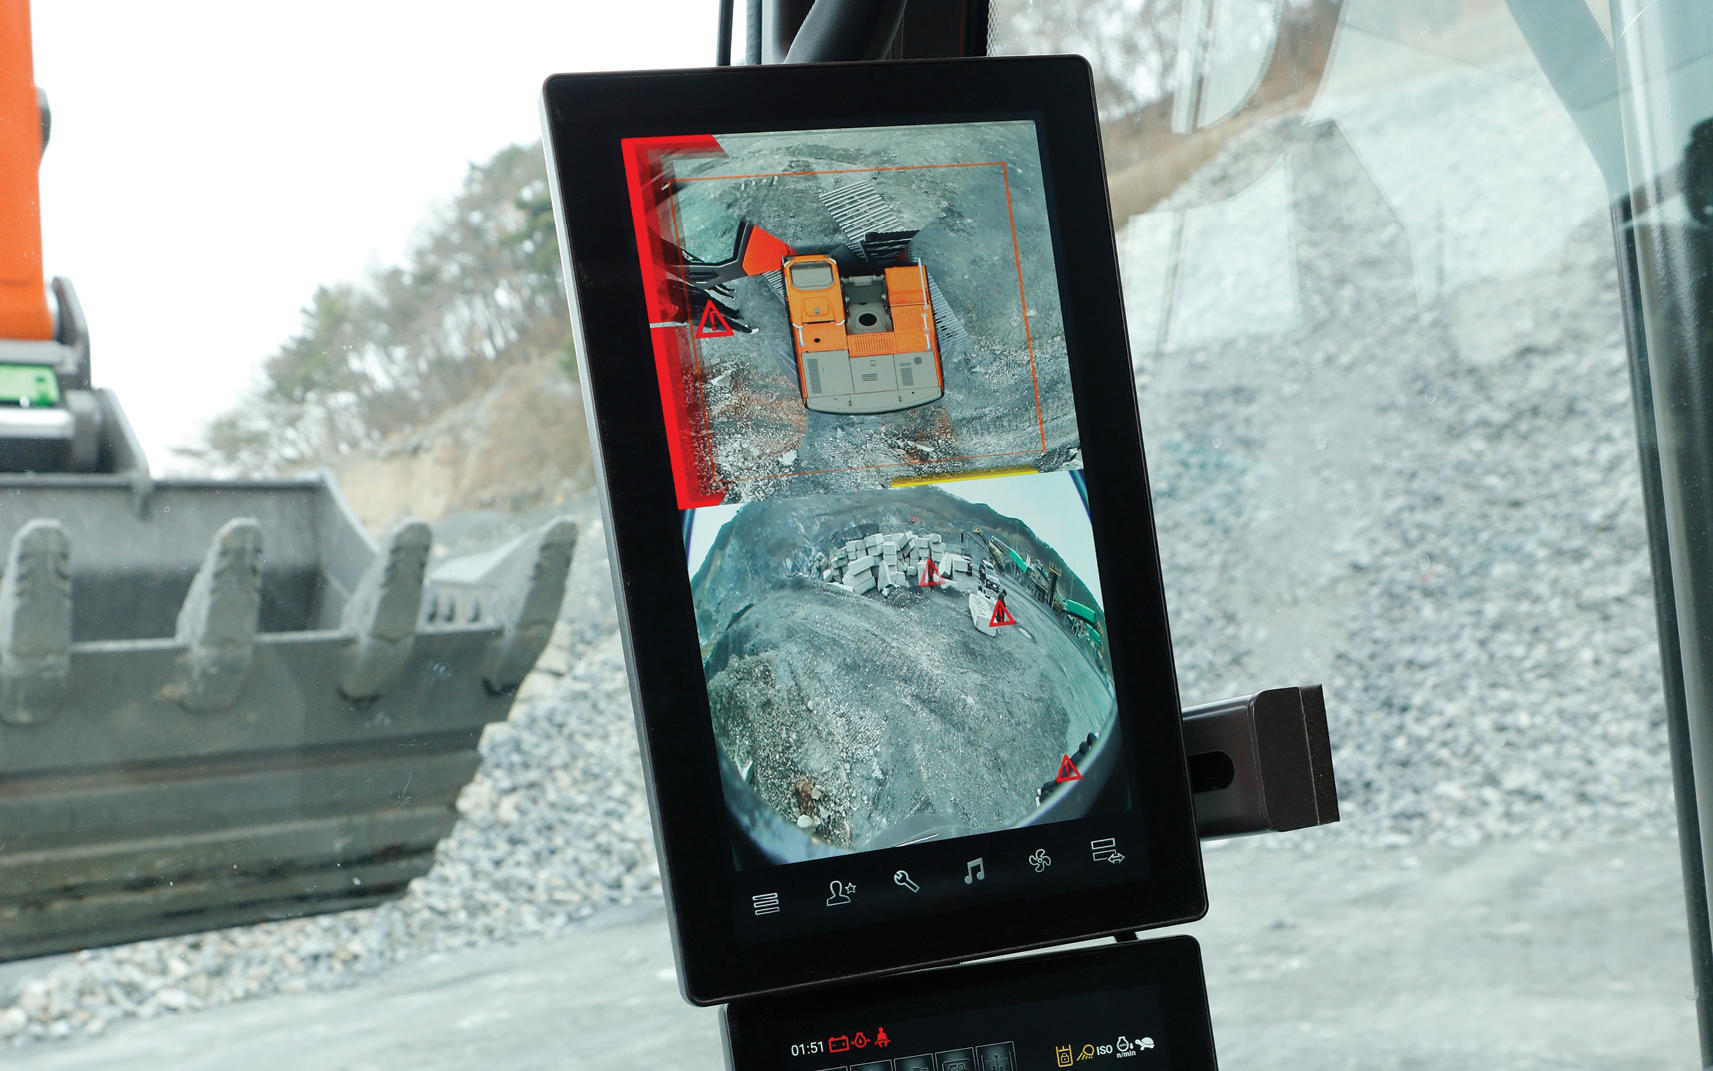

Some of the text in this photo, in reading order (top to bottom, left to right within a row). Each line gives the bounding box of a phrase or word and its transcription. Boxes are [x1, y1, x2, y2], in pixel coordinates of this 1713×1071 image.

[791, 1041, 824, 1056] 01:51
[1096, 1044, 1113, 1056] ISO
[1116, 1050, 1136, 1058] n/min
